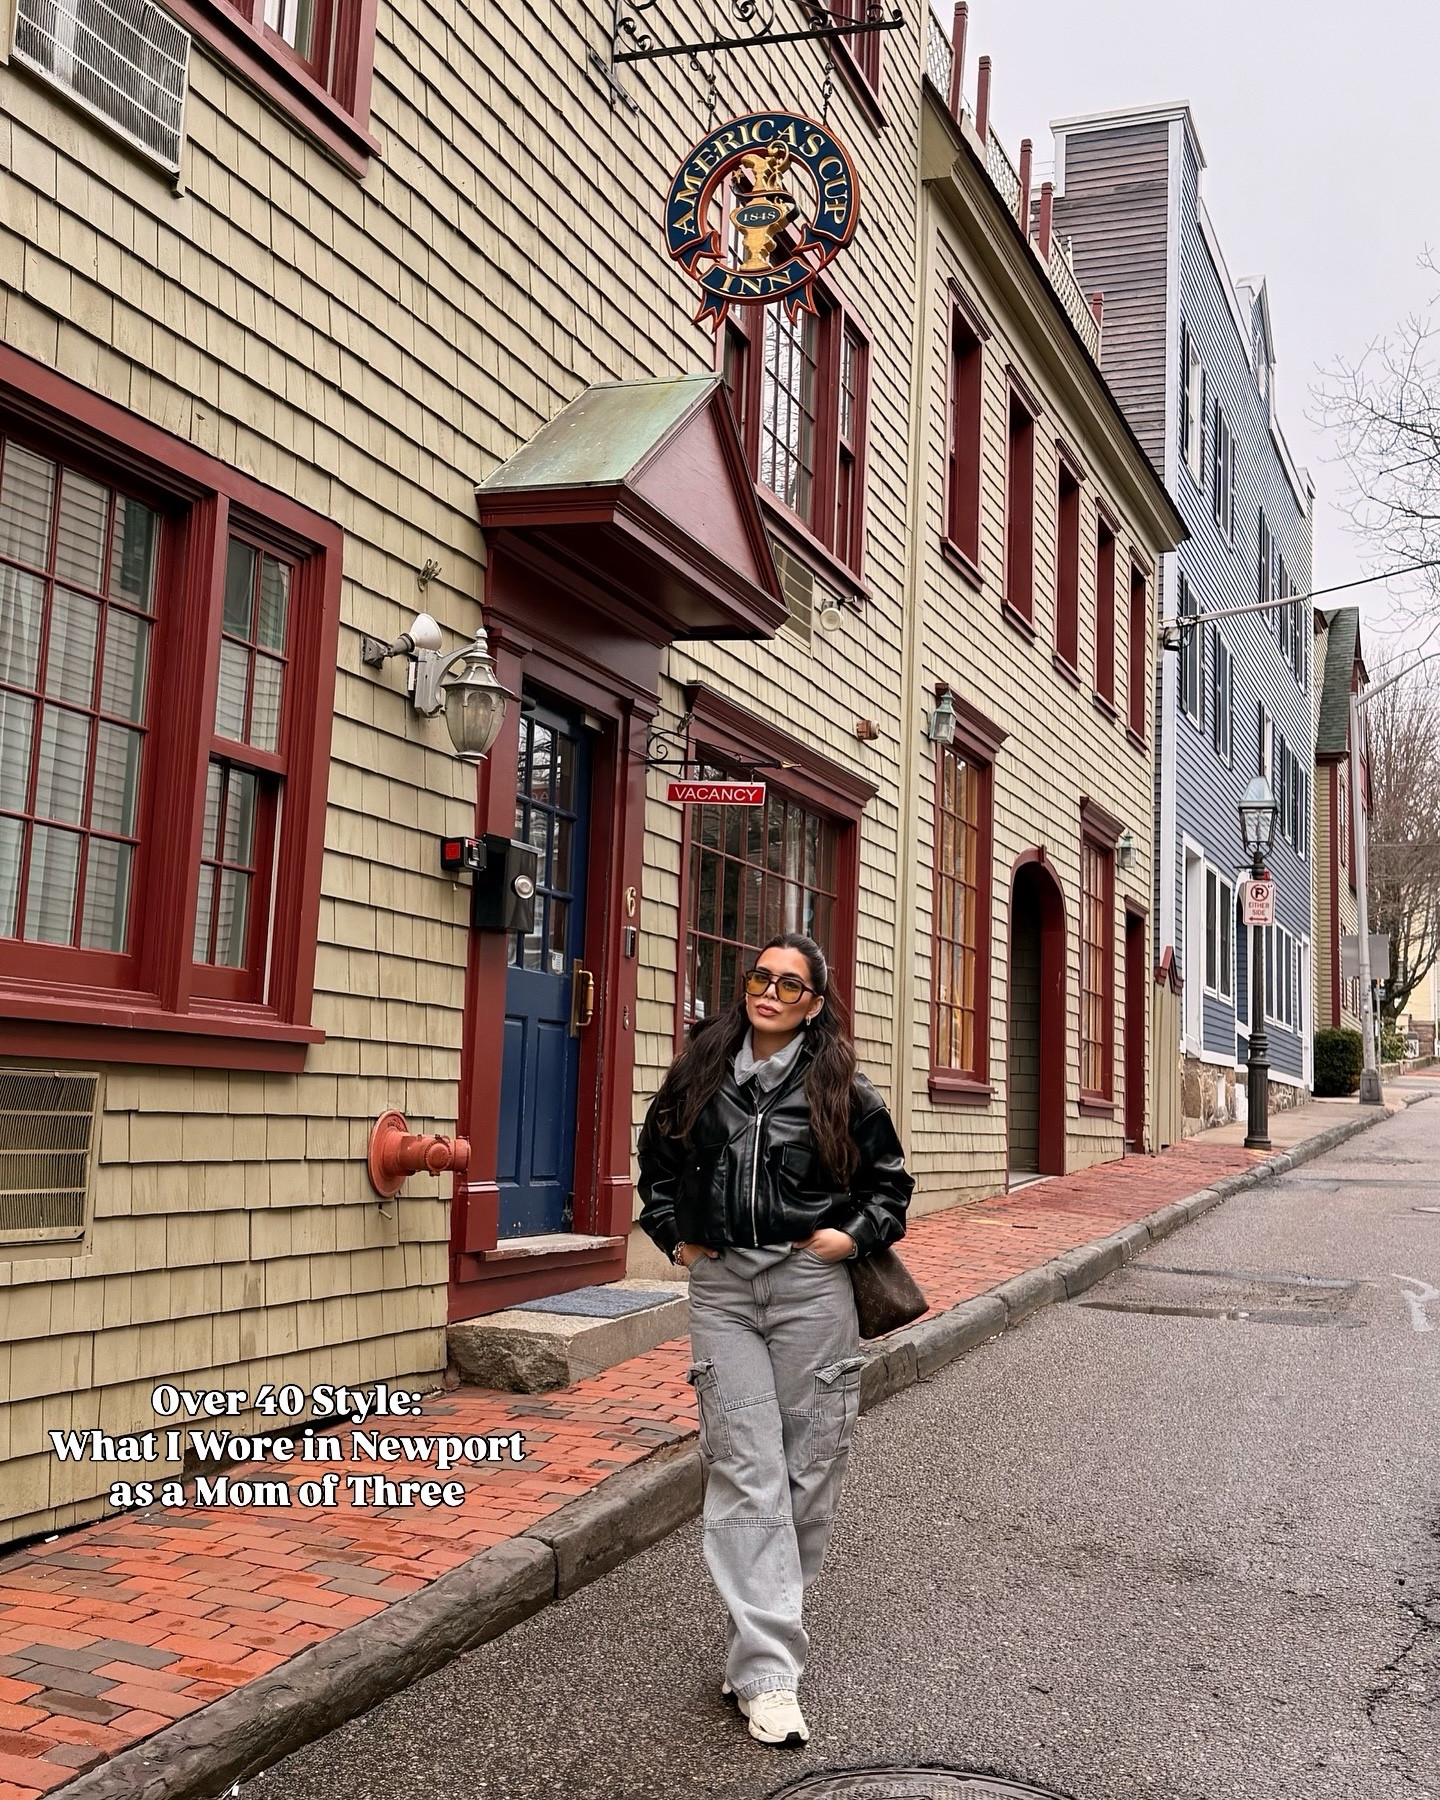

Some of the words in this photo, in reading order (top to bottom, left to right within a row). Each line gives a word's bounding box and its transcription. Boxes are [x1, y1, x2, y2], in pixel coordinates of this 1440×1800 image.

[671, 118, 826, 235] AMERICA'S
[818, 155, 848, 225] CUP
[719, 268, 792, 295] INN
[674, 786, 758, 802] VACANCY
[625, 886, 637, 918] 6
